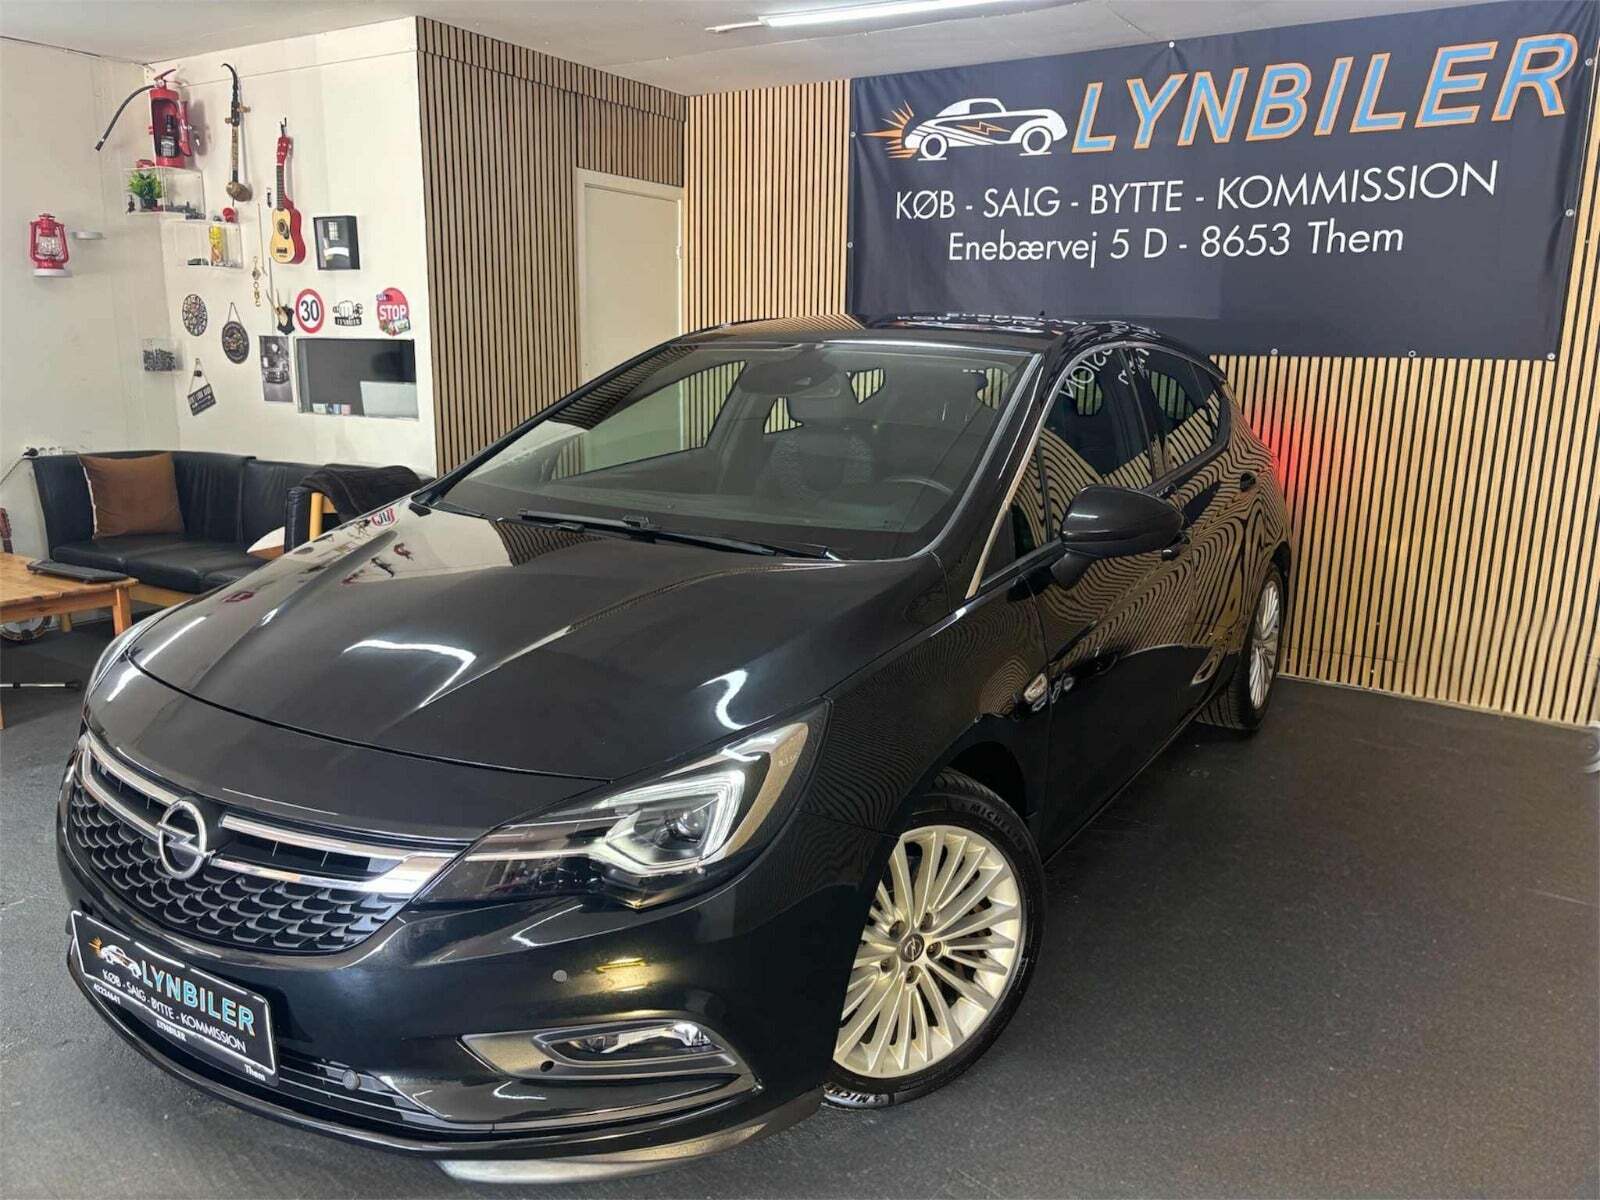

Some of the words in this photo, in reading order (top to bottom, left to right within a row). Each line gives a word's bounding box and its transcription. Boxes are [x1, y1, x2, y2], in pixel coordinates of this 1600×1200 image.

[1070, 32, 1580, 154] LYNBILER
[895, 188, 956, 221] KØB
[983, 185, 1060, 219] SALG
[1089, 180, 1184, 215] BYTTE
[1216, 159, 1499, 210] KOMMISSION
[949, 229, 1099, 268] Enebærvej
[1111, 229, 1129, 260] 5
[1143, 228, 1168, 259] D
[1200, 222, 1292, 257] 8653
[1307, 218, 1405, 254] Them
[300, 299, 320, 321] 30
[379, 305, 406, 320] STOP
[141, 960, 256, 1037] LYNBILER
[180, 1013, 246, 1053] KOMMISSION
[245, 1064, 265, 1081] Them
